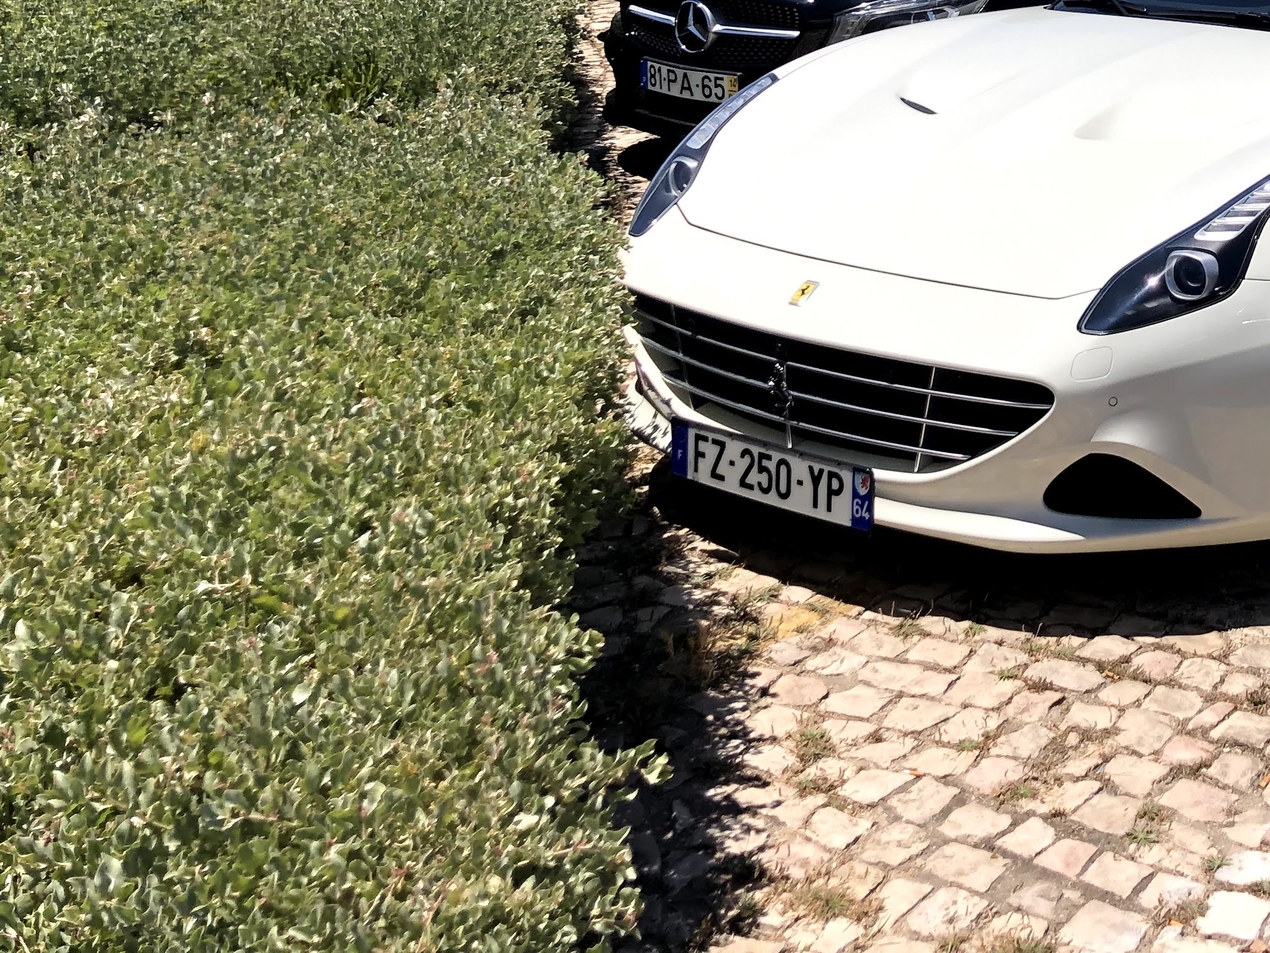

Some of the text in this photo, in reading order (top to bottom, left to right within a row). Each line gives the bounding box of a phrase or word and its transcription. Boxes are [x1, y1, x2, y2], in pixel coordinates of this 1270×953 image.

[677, 432, 870, 520] F FZ-250-YP 64
